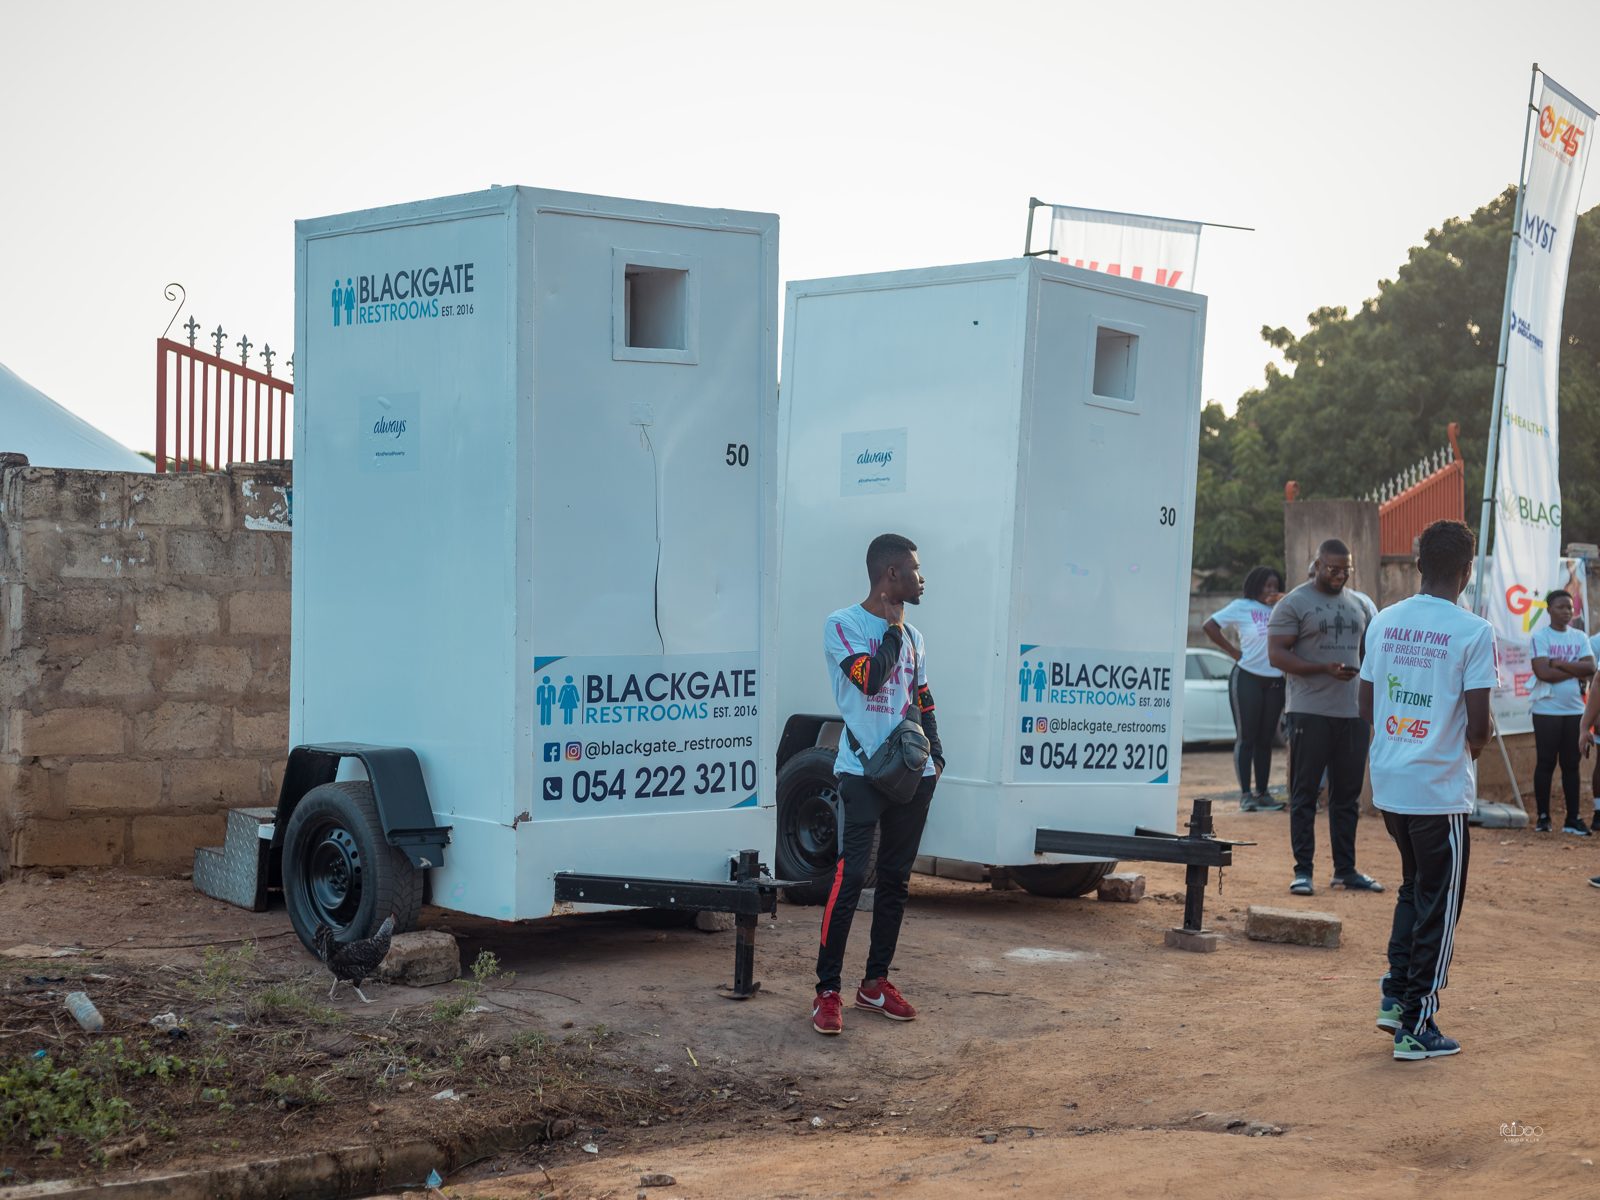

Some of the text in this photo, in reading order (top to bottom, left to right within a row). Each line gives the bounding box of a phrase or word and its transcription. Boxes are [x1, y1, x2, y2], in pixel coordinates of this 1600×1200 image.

[1524, 208, 1557, 254] MYST
[359, 262, 474, 304] BLACKGATE
[359, 298, 474, 325] RESTROOMS EST. 2016
[373, 415, 407, 439] always
[726, 443, 749, 467] 50
[857, 448, 893, 468] always
[1159, 506, 1176, 527] 30
[1384, 627, 1452, 647] WALK IN PINK
[1381, 642, 1448, 660] FOR BREAST CANCER
[1393, 655, 1432, 669] AWARENESS
[586, 669, 757, 704] BLACKGATE
[1051, 662, 1171, 691] BLACKGATE
[1051, 689, 1171, 708] RESTROOMS EST. 2016
[1395, 690, 1434, 708] FITZONE
[585, 702, 758, 724] RESTROOMS EST. 2016
[1050, 718, 1167, 735] @blackgate_restrooms
[585, 735, 753, 760] @blackgate_restrooms
[1040, 742, 1168, 770] 054 222 3210
[572, 759, 757, 803] 054 222 3210
